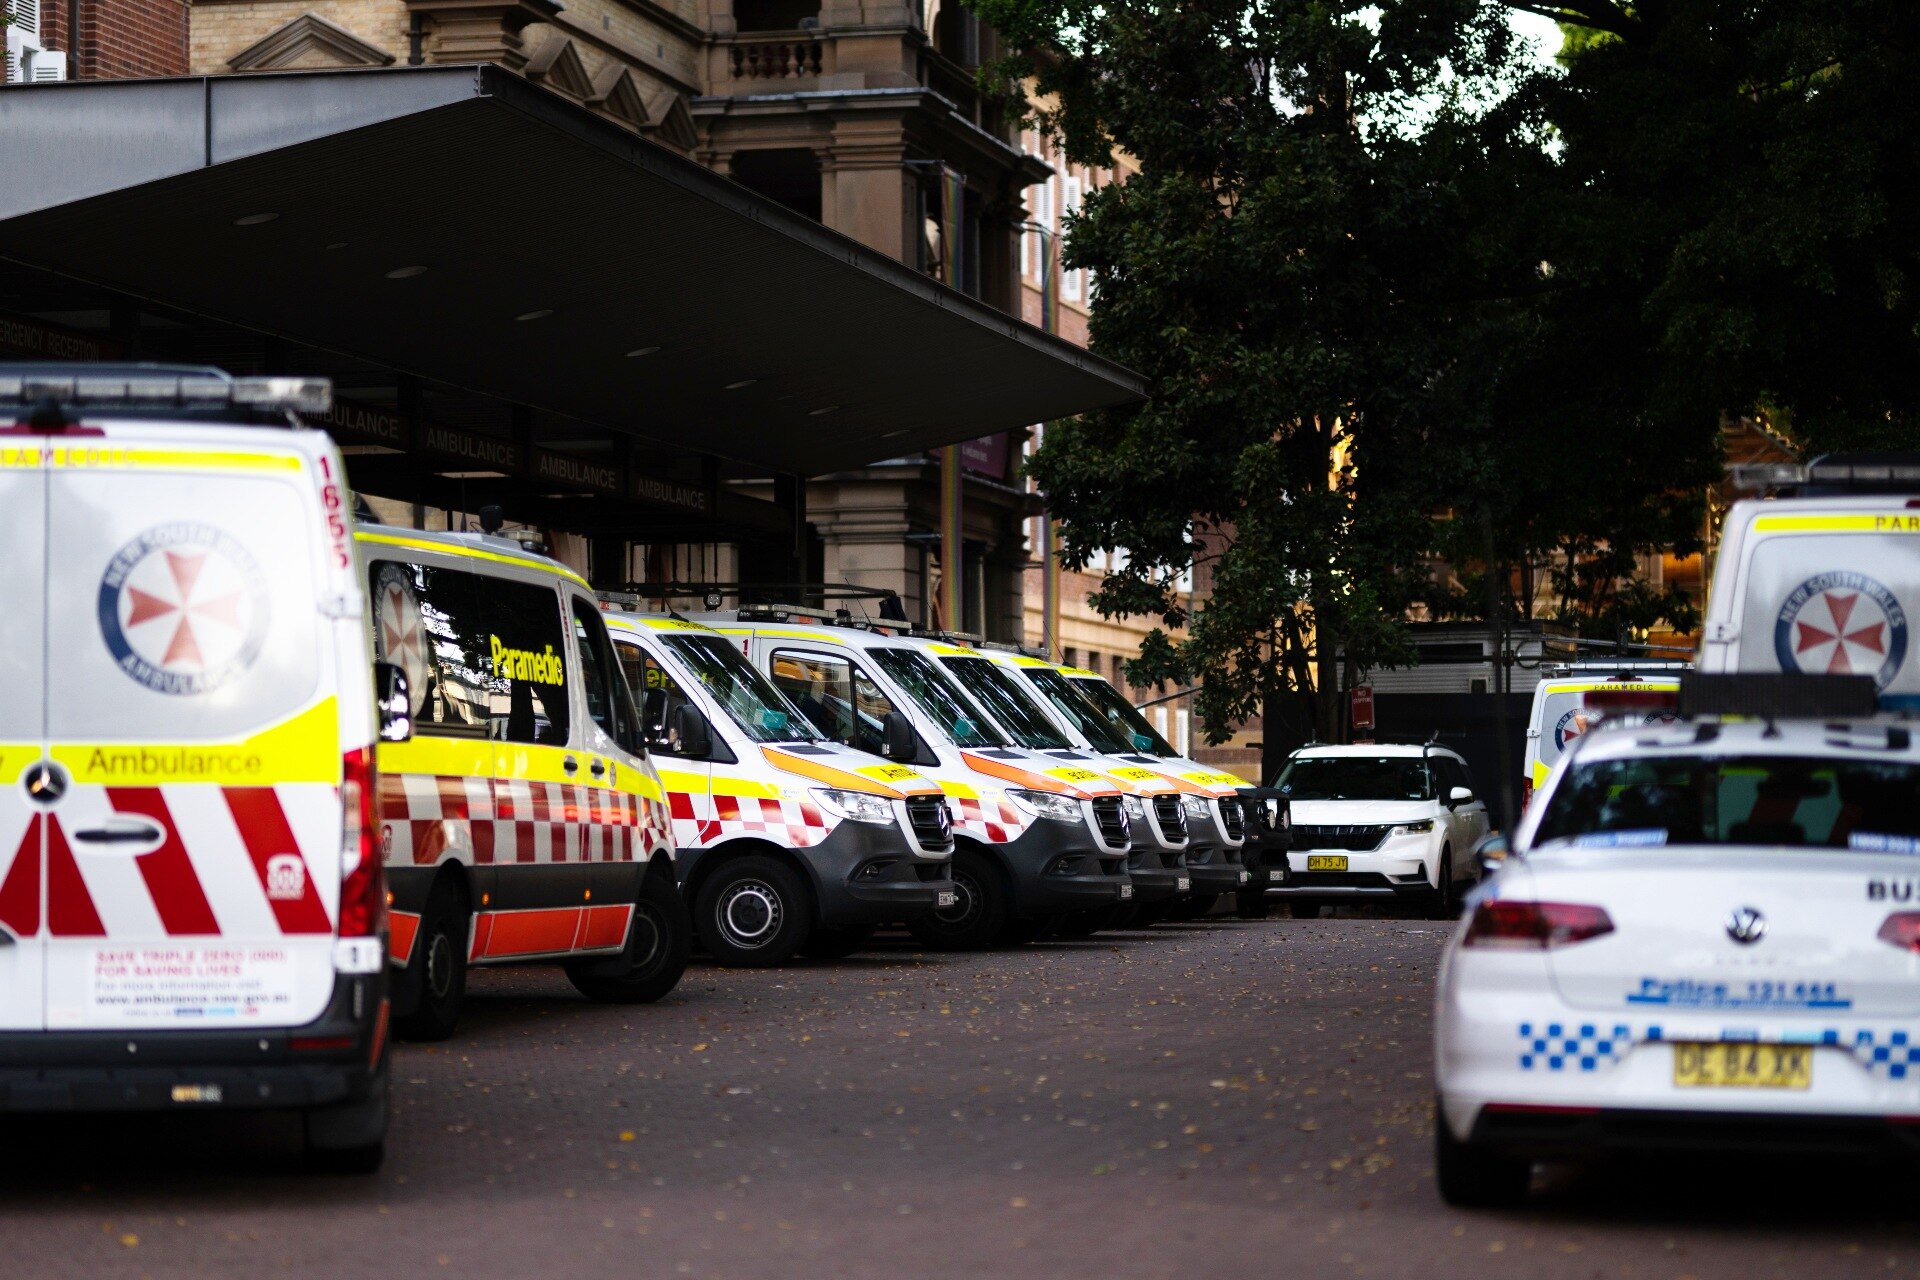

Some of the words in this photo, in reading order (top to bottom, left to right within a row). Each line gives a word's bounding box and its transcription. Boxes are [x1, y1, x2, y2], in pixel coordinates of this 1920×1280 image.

[0, 448, 137, 467] AMEDIC
[426, 427, 516, 467] AMBULANCE
[539, 454, 616, 489] AMBULANCE
[638, 478, 706, 510] AMBULANCE
[1780, 587, 1809, 624] NEW
[1809, 573, 1864, 595] SOUTH
[1867, 580, 1905, 633] WALES
[491, 635, 564, 687] Paramedic
[1557, 715, 1569, 731] NEW
[87, 748, 261, 776] Ambulance
[1309, 858, 1320, 867] DH
[1323, 858, 1333, 867] 75
[1336, 858, 1345, 866] JY
[1868, 881, 1920, 902] BU
[1643, 979, 1728, 999] Police
